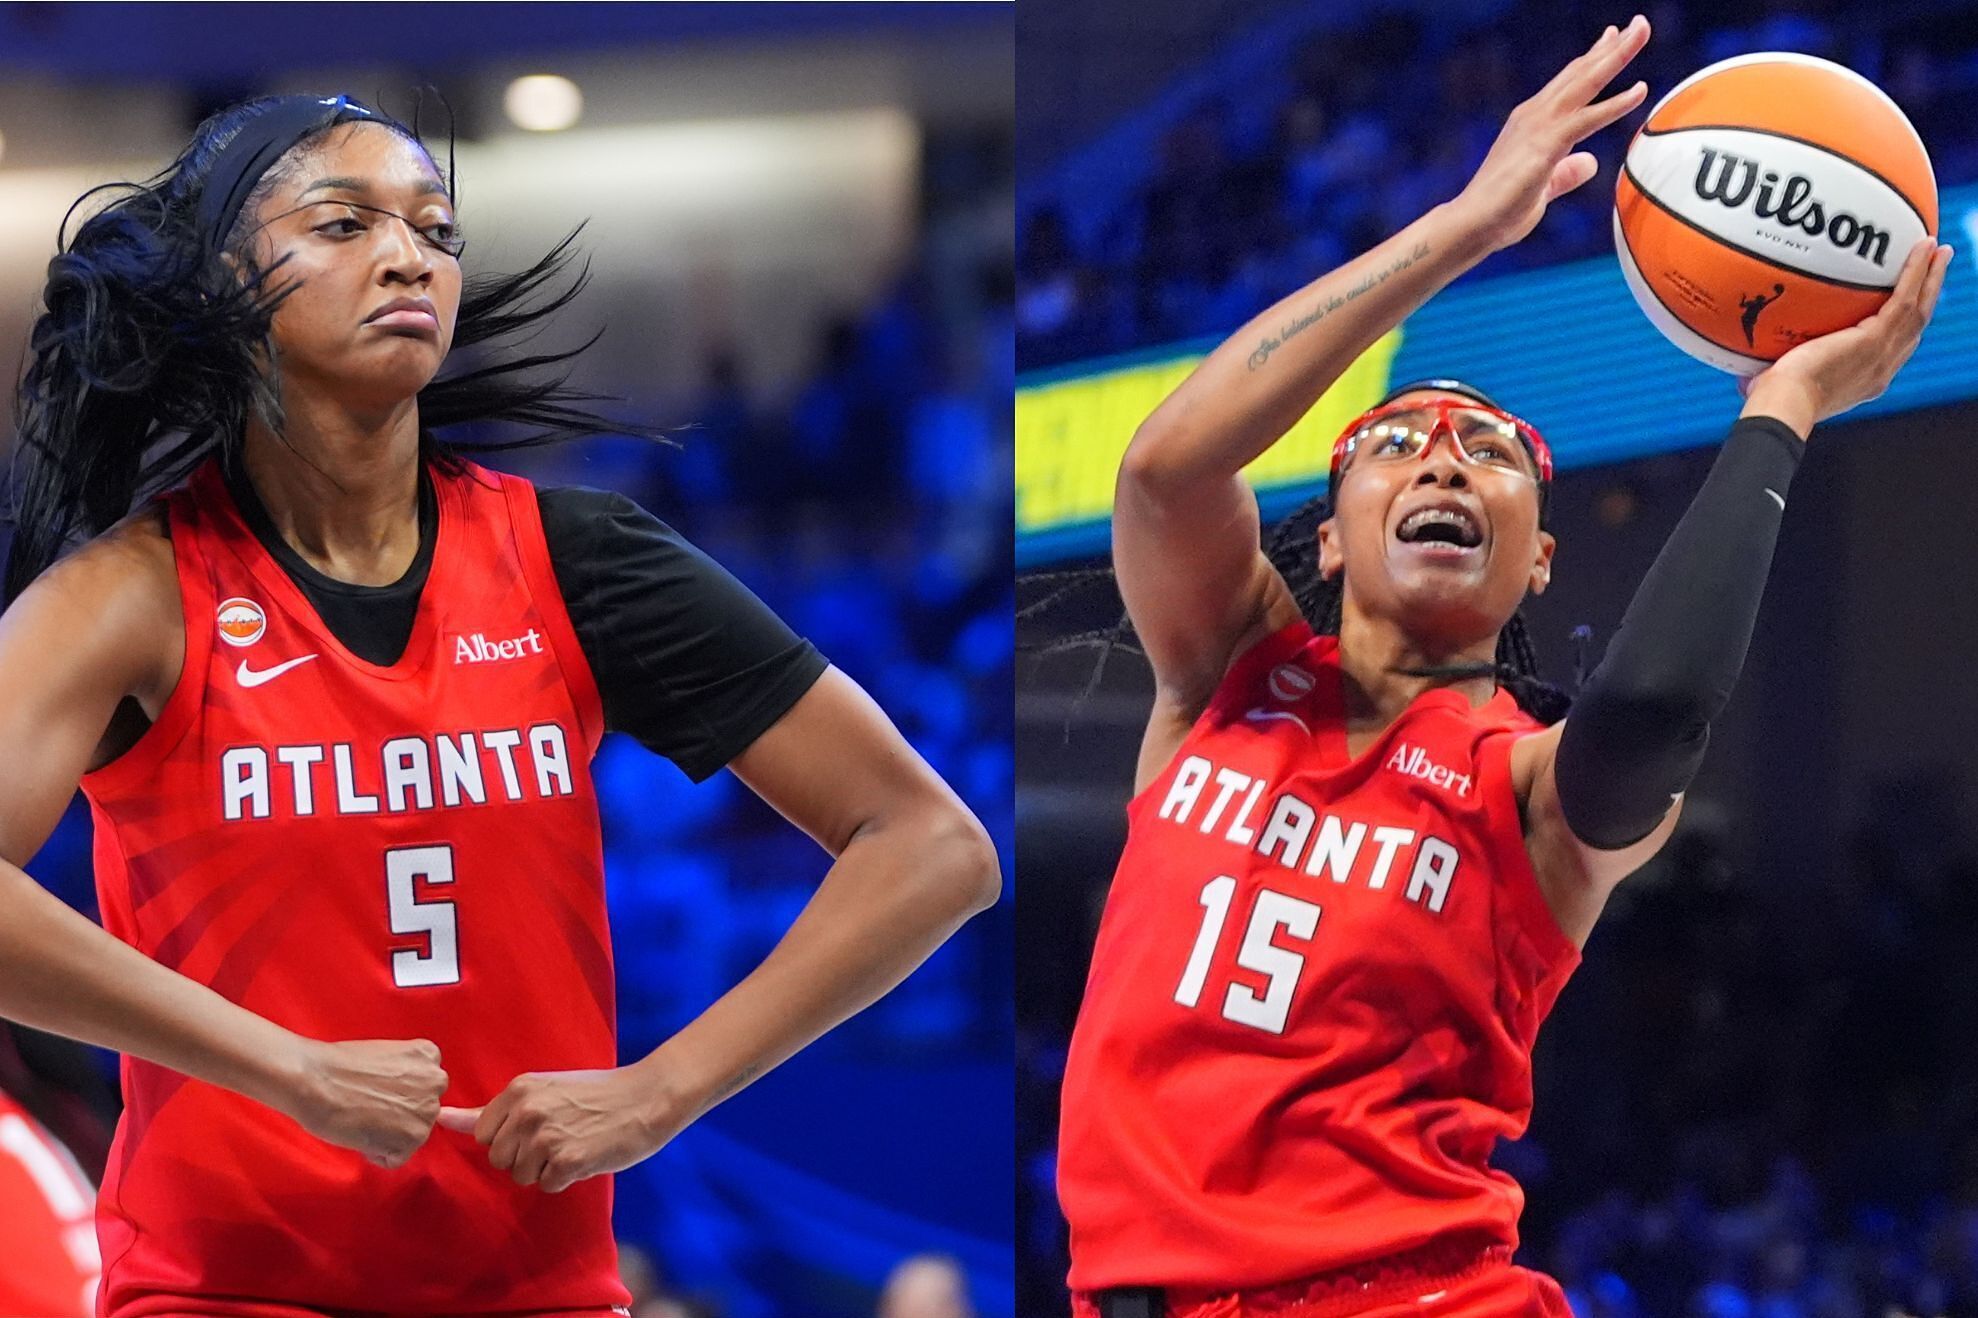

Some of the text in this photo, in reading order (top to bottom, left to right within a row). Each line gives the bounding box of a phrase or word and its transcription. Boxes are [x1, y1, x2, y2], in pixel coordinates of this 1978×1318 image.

[1694, 146, 1890, 267] Wilson
[454, 628, 544, 665] Albert
[221, 722, 575, 822] ATLANTA
[1386, 743, 1472, 798] Albert
[1158, 755, 1460, 915] ATLANTA
[384, 844, 462, 989] 5
[1173, 874, 1322, 1036] 15
